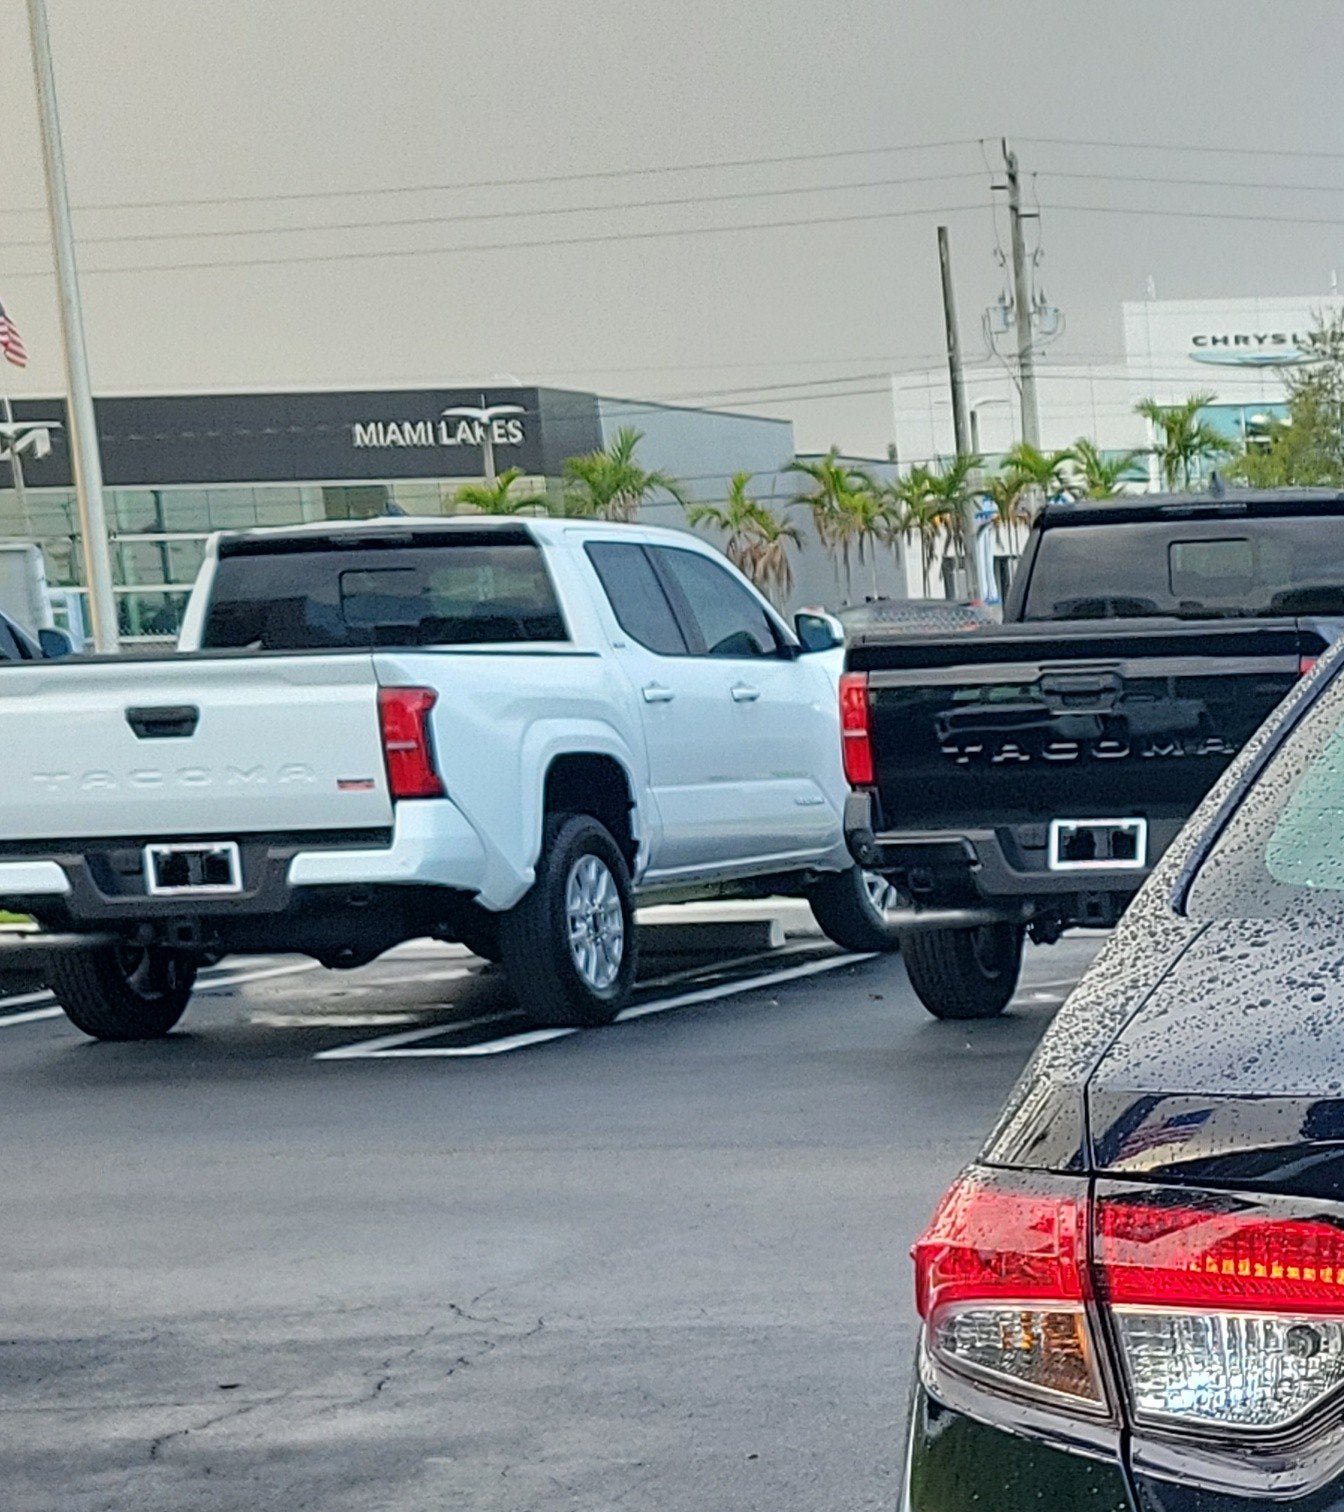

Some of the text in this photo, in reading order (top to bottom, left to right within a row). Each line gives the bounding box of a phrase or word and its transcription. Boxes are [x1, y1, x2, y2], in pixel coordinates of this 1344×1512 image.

[1192, 333, 1305, 347] CHRYSL
[353, 421, 435, 448] MIAMI
[940, 738, 1236, 764] TACOMA
[32, 762, 314, 792] TACOMA
